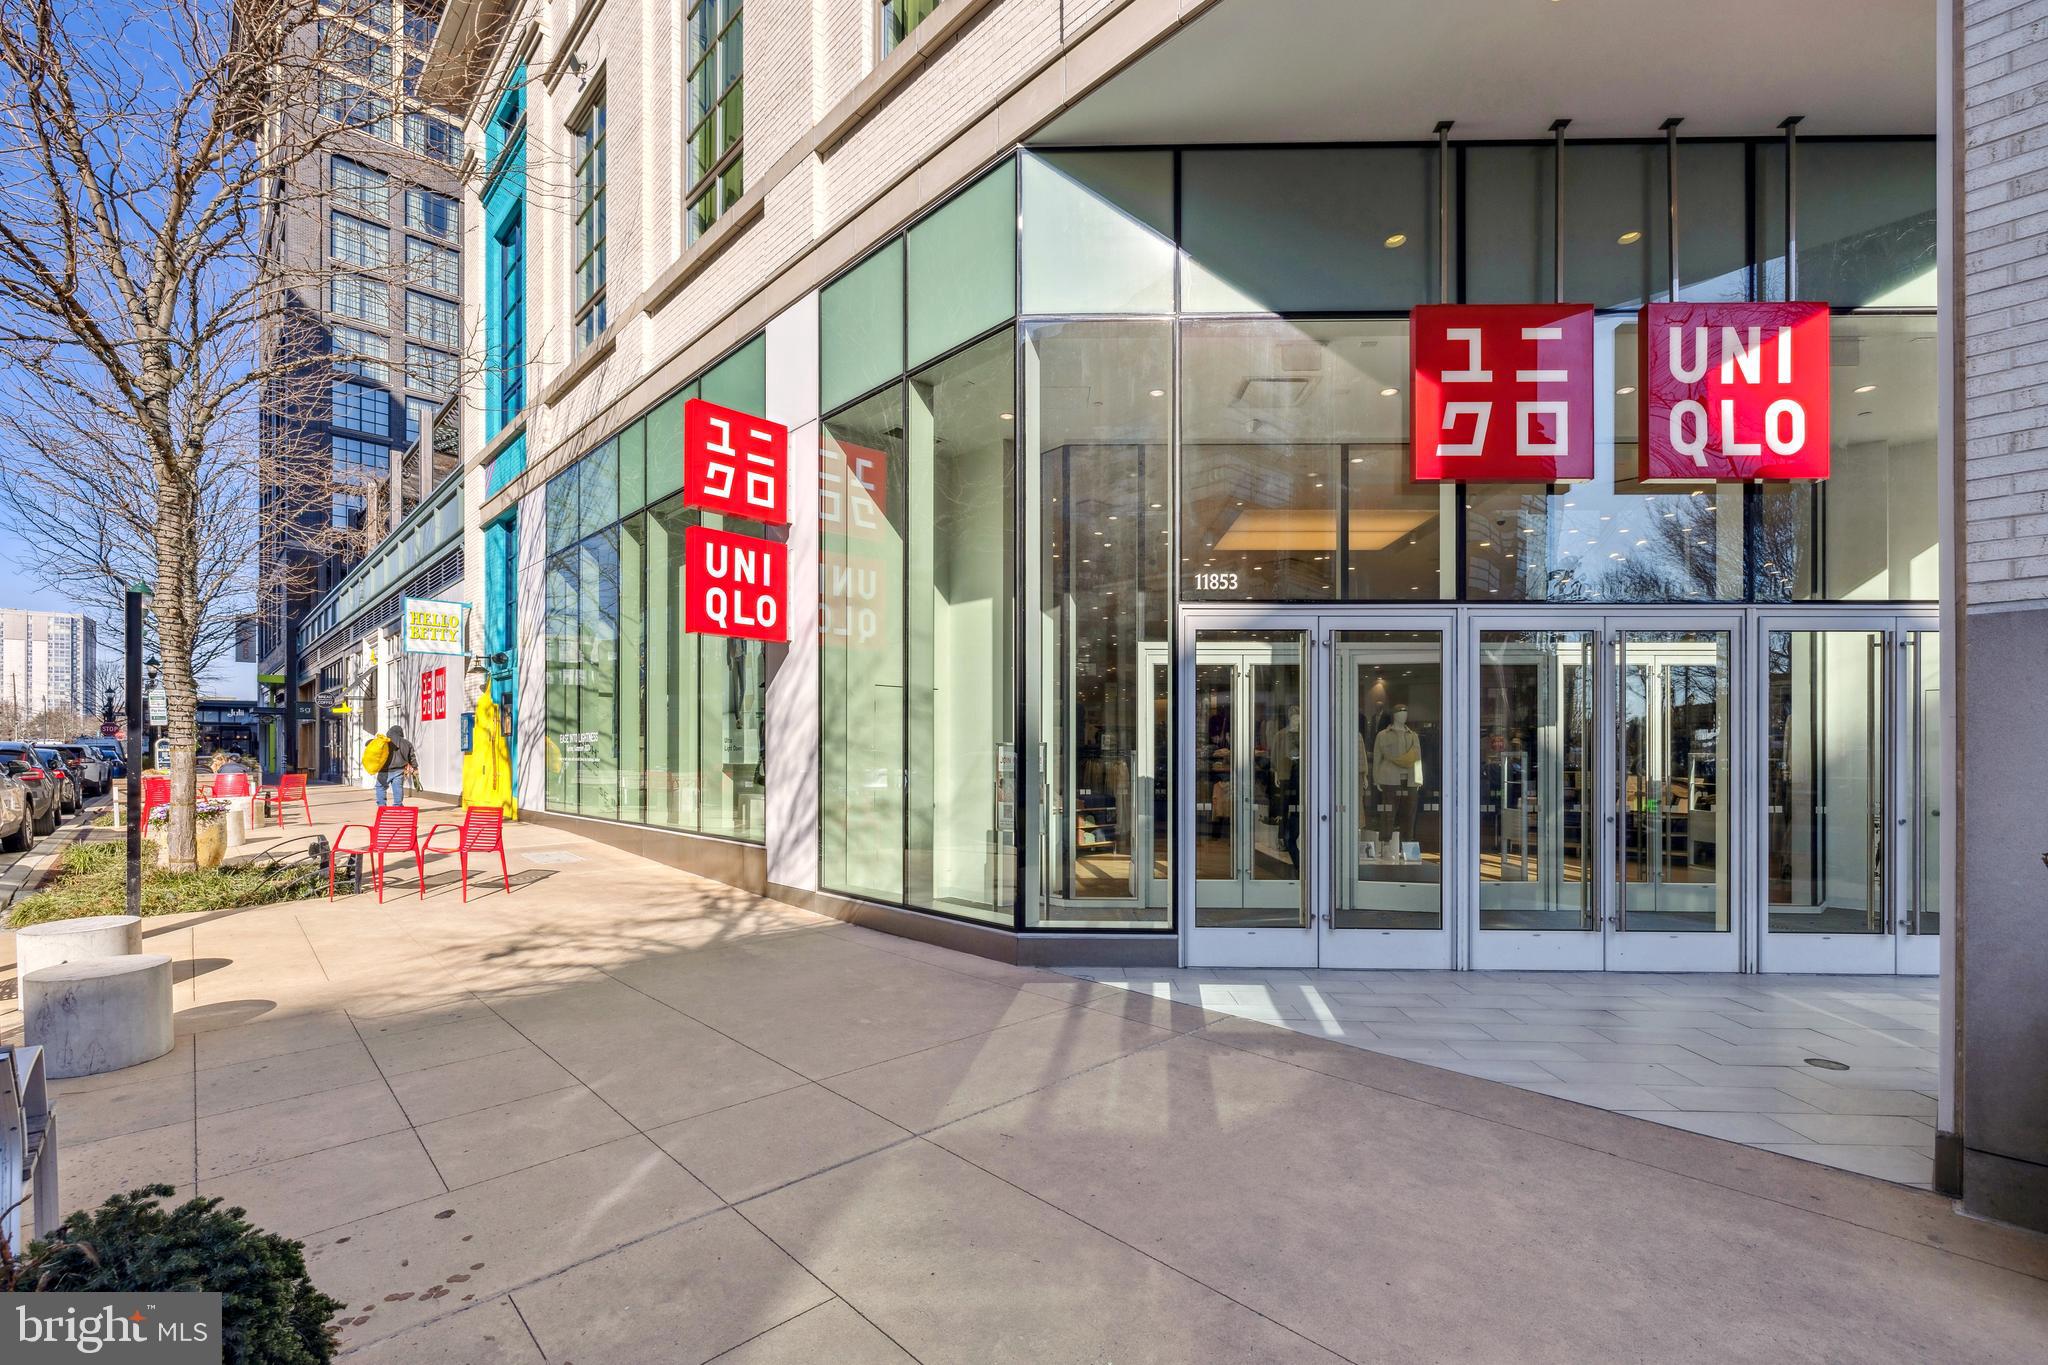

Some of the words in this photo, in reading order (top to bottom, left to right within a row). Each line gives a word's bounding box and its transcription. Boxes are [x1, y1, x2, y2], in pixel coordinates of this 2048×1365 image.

[1669, 326, 1792, 385] UNI
[1669, 399, 1806, 467] QLO
[705, 541, 771, 587] UNI
[1194, 573, 1238, 590] 11853
[410, 611, 459, 627] HELLO
[705, 586, 777, 629] QLO
[410, 625, 459, 642] BETTY
